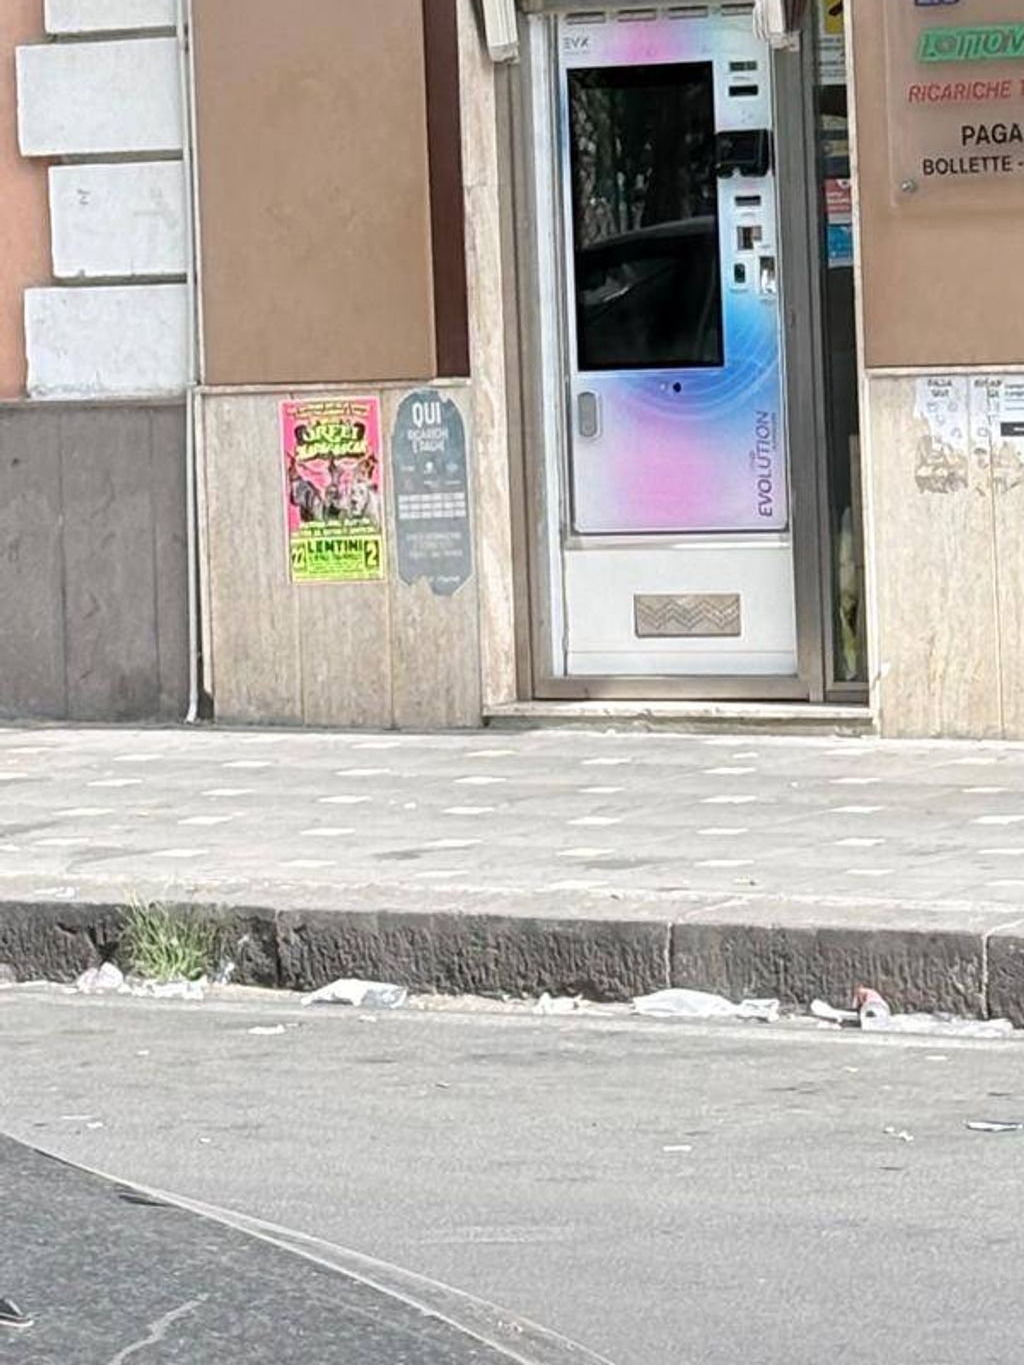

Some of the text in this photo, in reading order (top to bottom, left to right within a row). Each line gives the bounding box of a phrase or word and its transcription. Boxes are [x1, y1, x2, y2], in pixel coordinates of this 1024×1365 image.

[908, 80, 1012, 102] RICARICHE
[922, 155, 1013, 175] BOLLETTE
[412, 401, 441, 428] QUI
[756, 410, 773, 518] EVOLUTION
